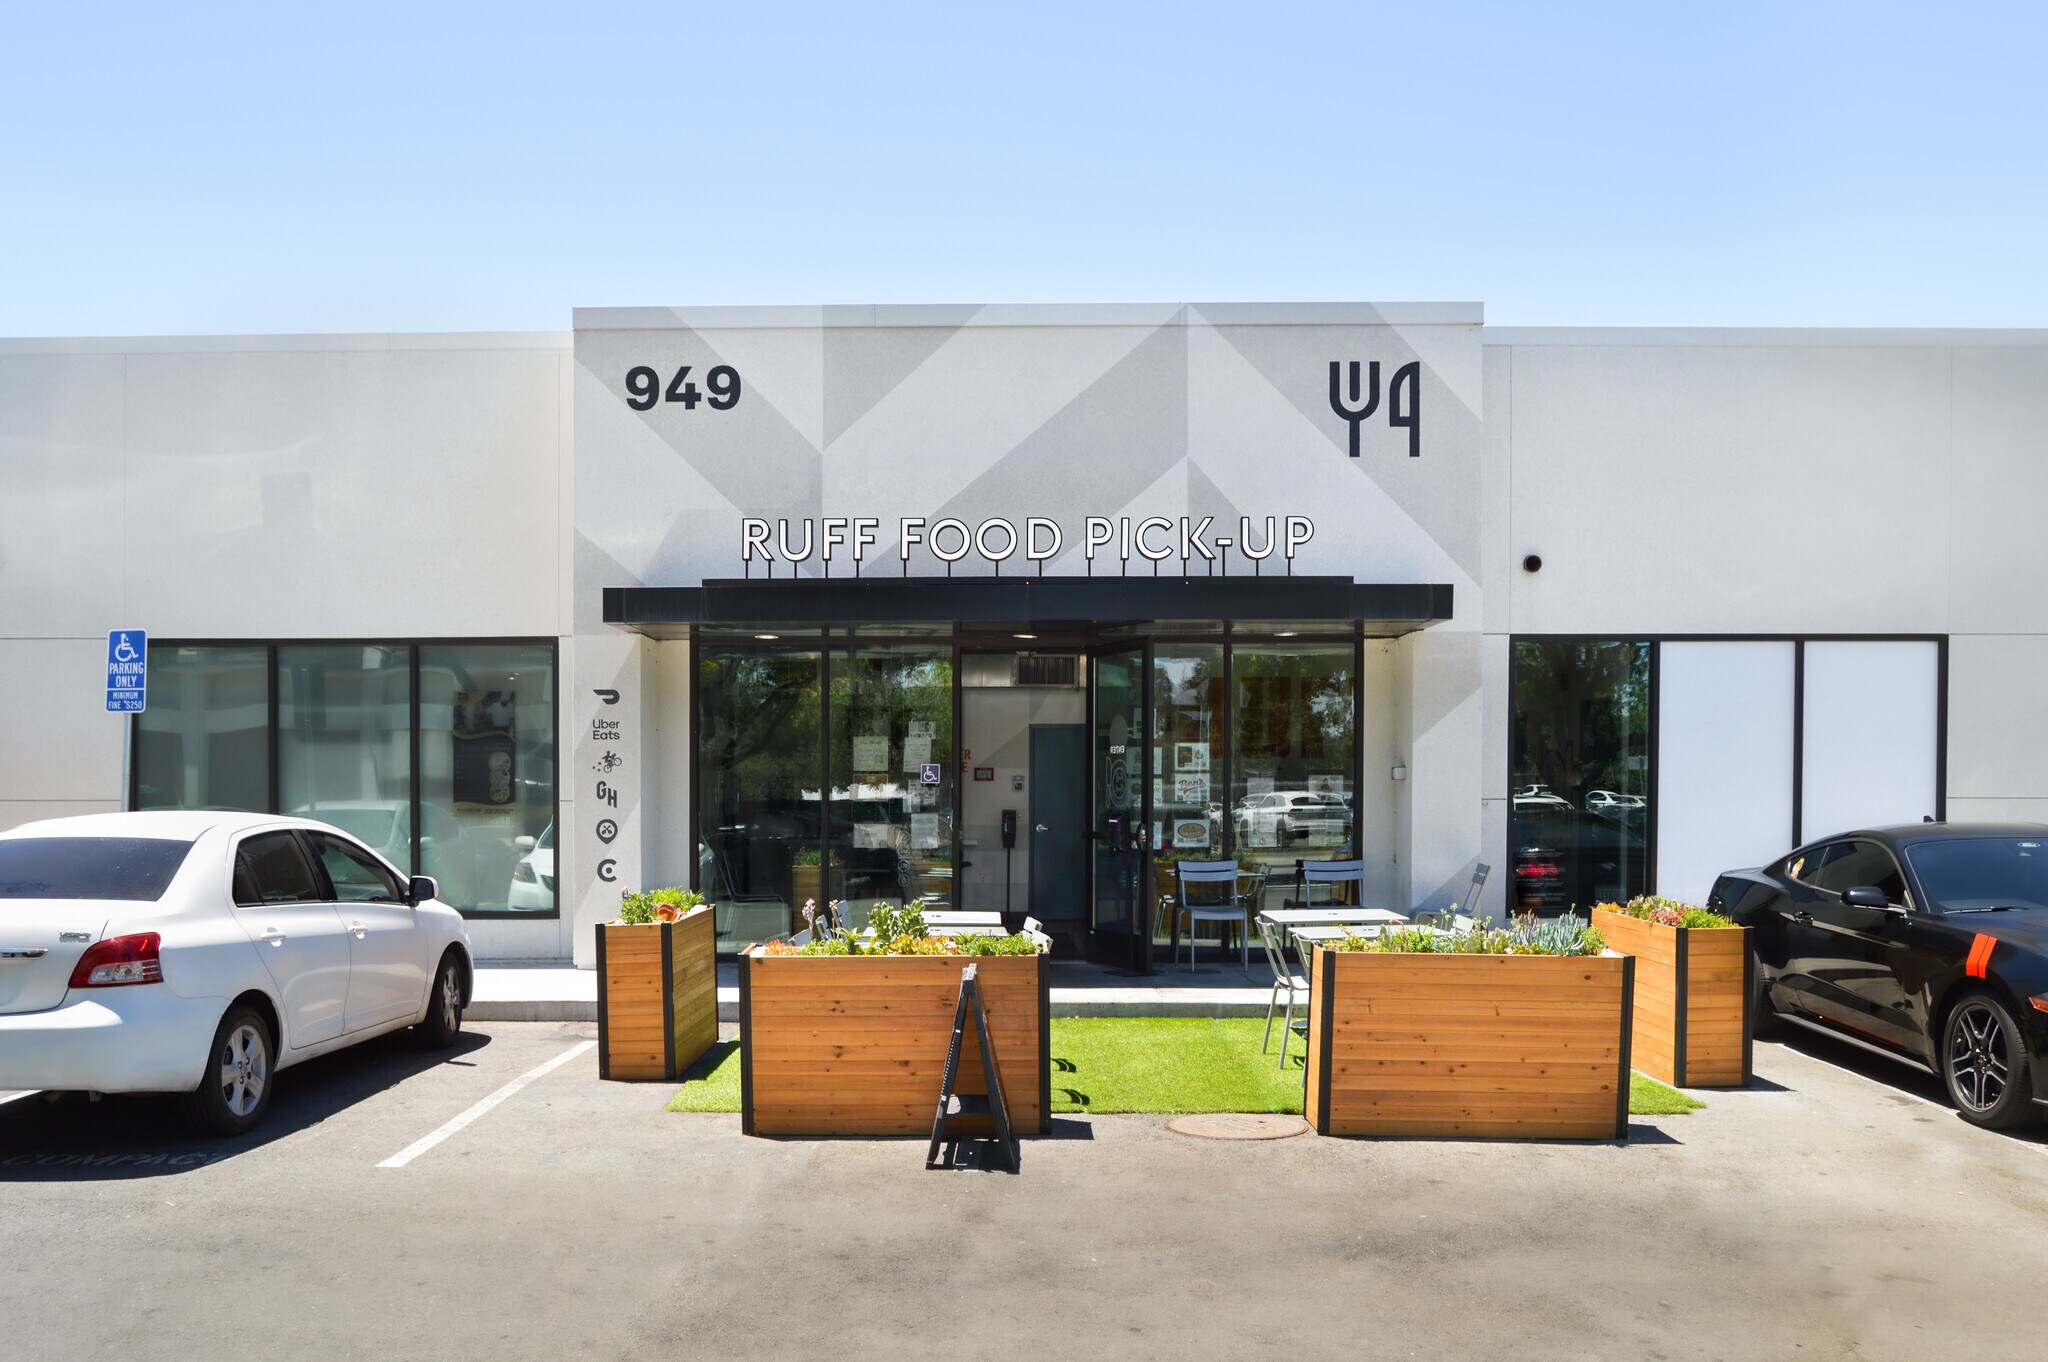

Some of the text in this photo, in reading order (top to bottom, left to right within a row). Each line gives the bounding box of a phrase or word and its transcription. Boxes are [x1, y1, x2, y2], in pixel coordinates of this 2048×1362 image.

[625, 365, 741, 411] 949
[742, 516, 1315, 562] RUFF FOOD PICK-UP
[109, 662, 144, 675] PARKING
[115, 675, 138, 688] ONLY
[113, 691, 139, 700] MINIMUM
[108, 700, 143, 710] FINE $250
[592, 719, 620, 729] Uber
[592, 730, 620, 740] Eats
